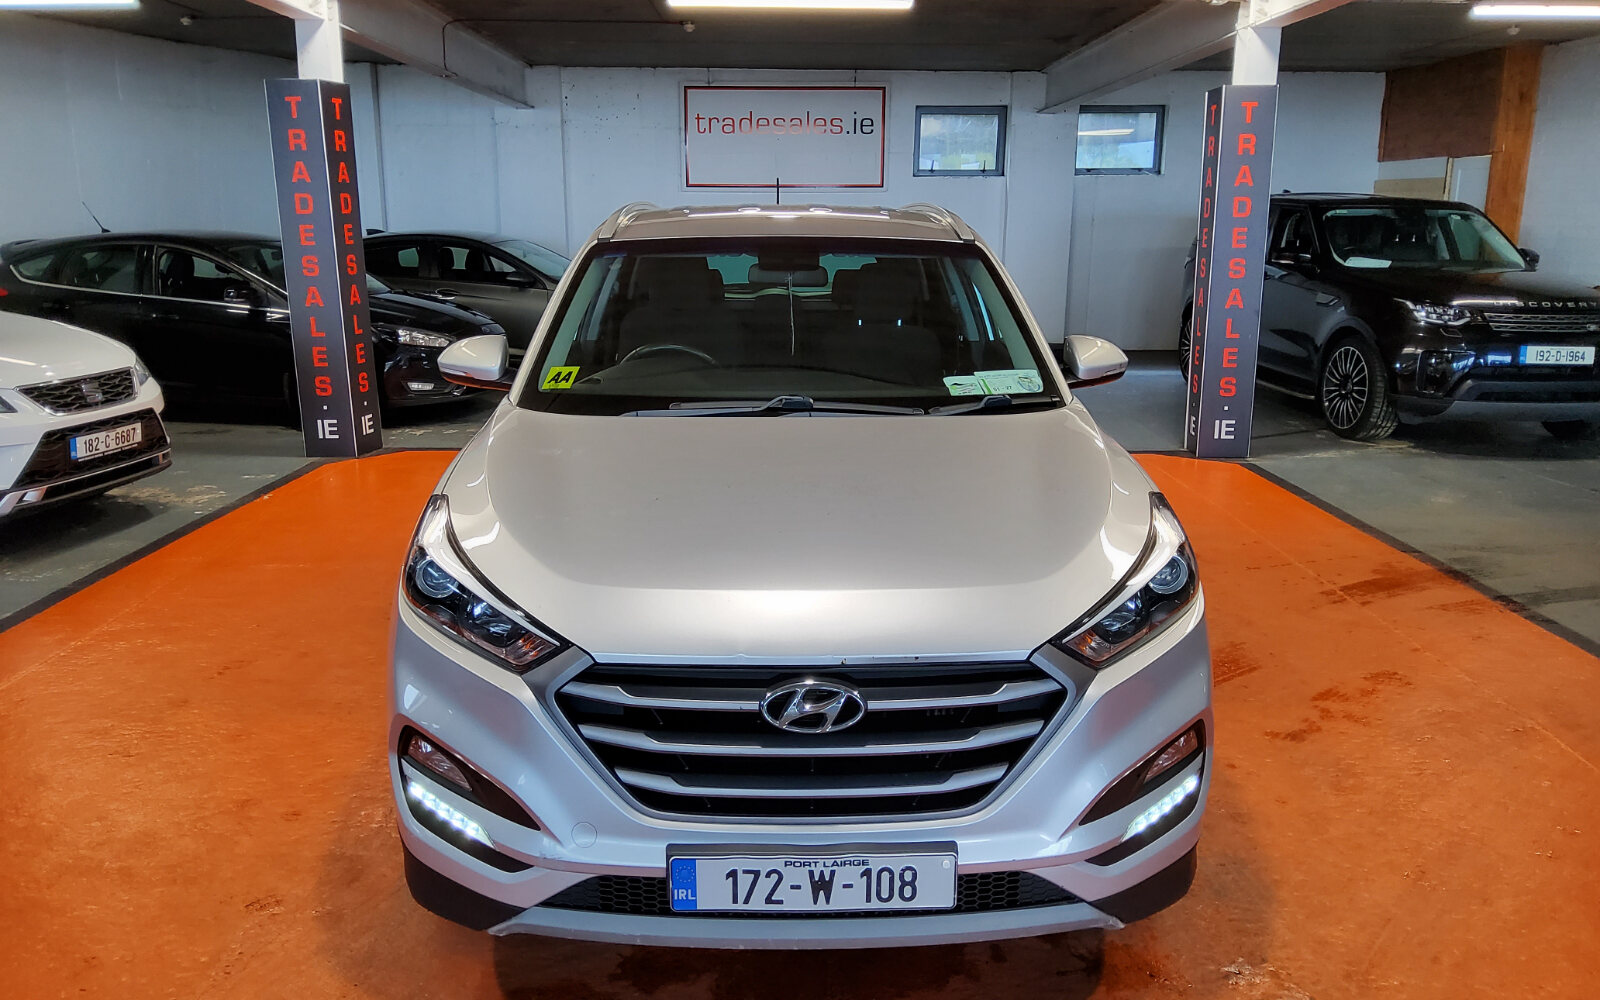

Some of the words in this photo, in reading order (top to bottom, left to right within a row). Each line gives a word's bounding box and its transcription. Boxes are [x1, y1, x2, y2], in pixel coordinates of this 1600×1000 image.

[695, 111, 874, 135] tradesales.ie
[1535, 350, 1586, 362] 192-D-1964
[547, 371, 573, 384] AA
[84, 427, 136, 454] 182-C-6687
[784, 860, 819, 868] PORT
[725, 866, 918, 905] 172-W-108
[674, 889, 696, 900] IRL
